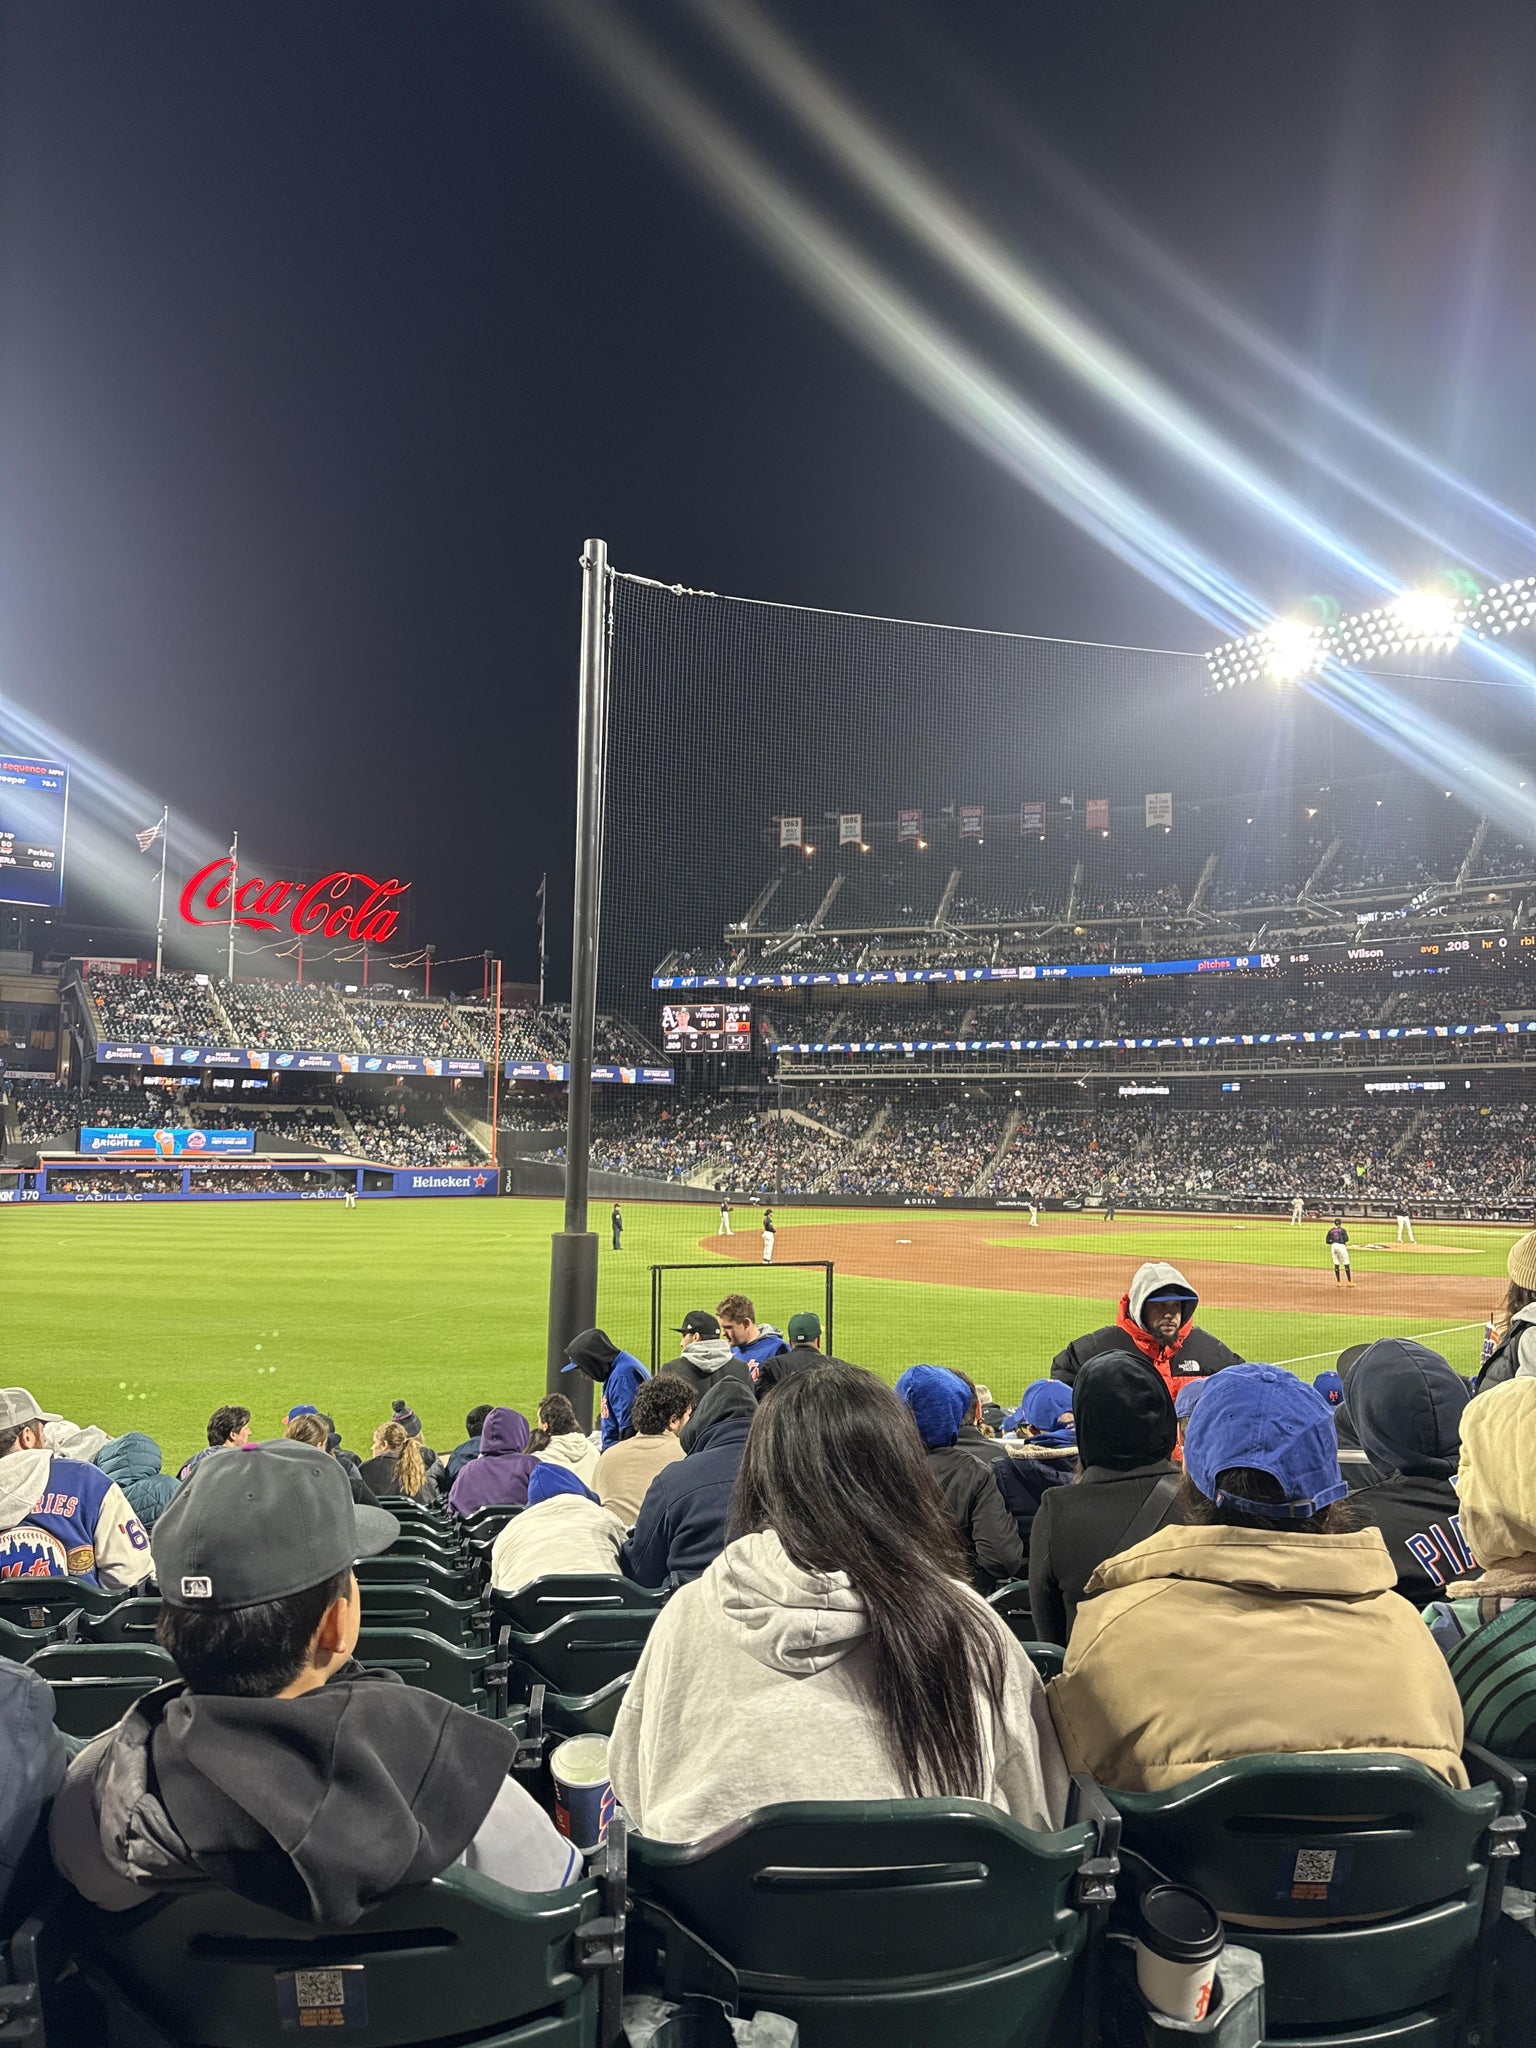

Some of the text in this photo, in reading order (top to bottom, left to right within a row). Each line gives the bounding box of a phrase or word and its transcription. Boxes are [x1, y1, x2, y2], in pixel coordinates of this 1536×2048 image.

[3, 763, 48, 778] sequence
[33, 860, 53, 869] 0.00
[178, 857, 411, 942] Coca-Cola
[1420, 940, 1470, 955] avg .208
[1481, 937, 1508, 949] hr 0
[1347, 948, 1384, 959] Wilson
[1109, 966, 1143, 975] Holmes
[1197, 958, 1249, 972] pitches 80
[658, 978, 673, 987] 8:37
[91, 1138, 143, 1149] BRIGHTER
[412, 1175, 471, 1188] Heineken
[21, 1190, 40, 1200] 370
[75, 1193, 143, 1202] CADILLAC
